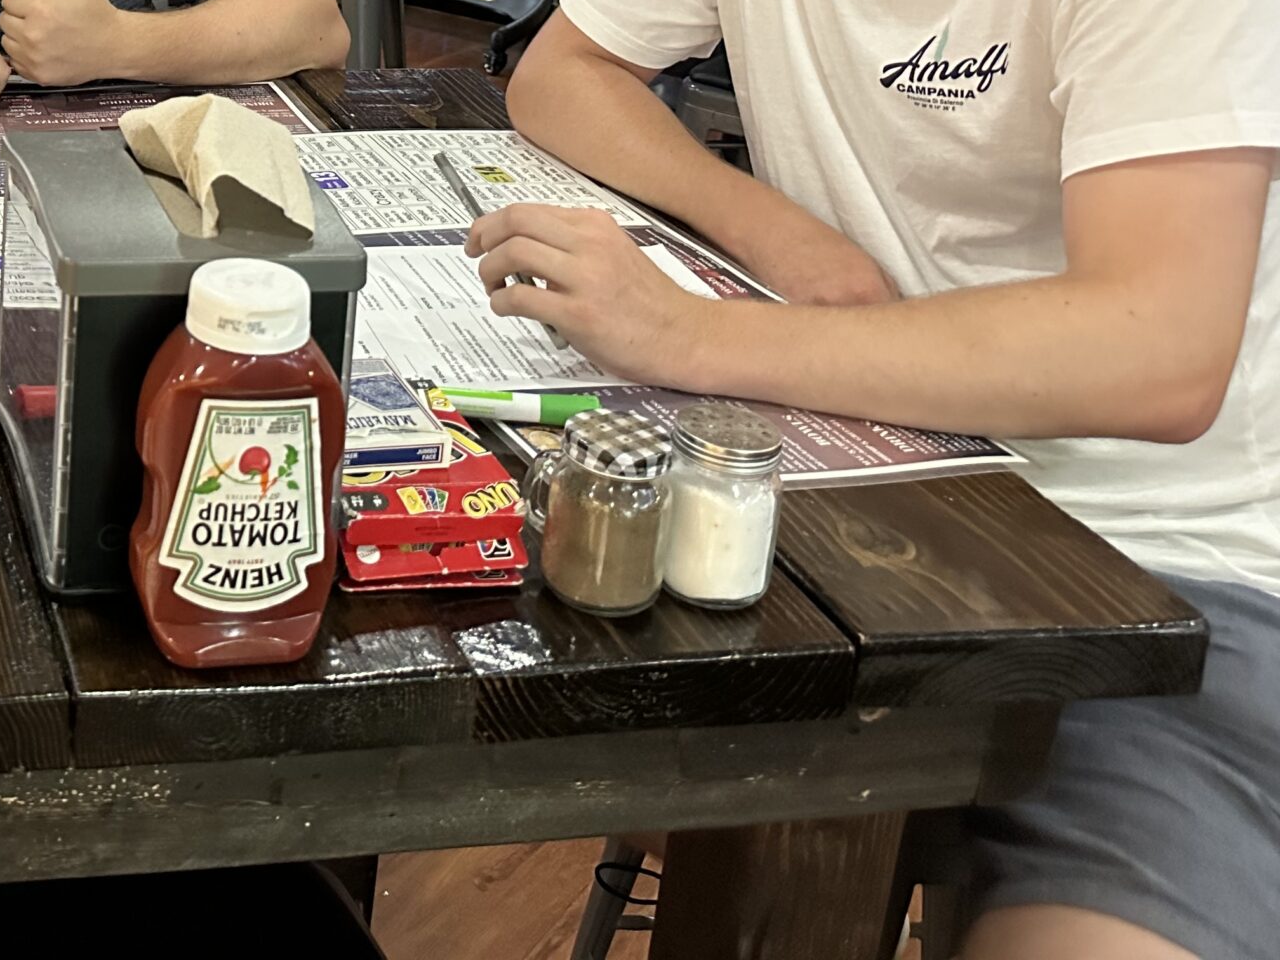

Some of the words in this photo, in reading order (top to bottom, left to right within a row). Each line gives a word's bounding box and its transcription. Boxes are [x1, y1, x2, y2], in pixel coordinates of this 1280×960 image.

[896, 83, 976, 99] CAMPANIA
[309, 172, 339, 182] 13
[471, 166, 504, 176] 14
[461, 479, 521, 519] UNO
[198, 500, 299, 522] KETCHUP
[191, 519, 302, 547] TOMATO
[202, 562, 284, 589] HEINZ
